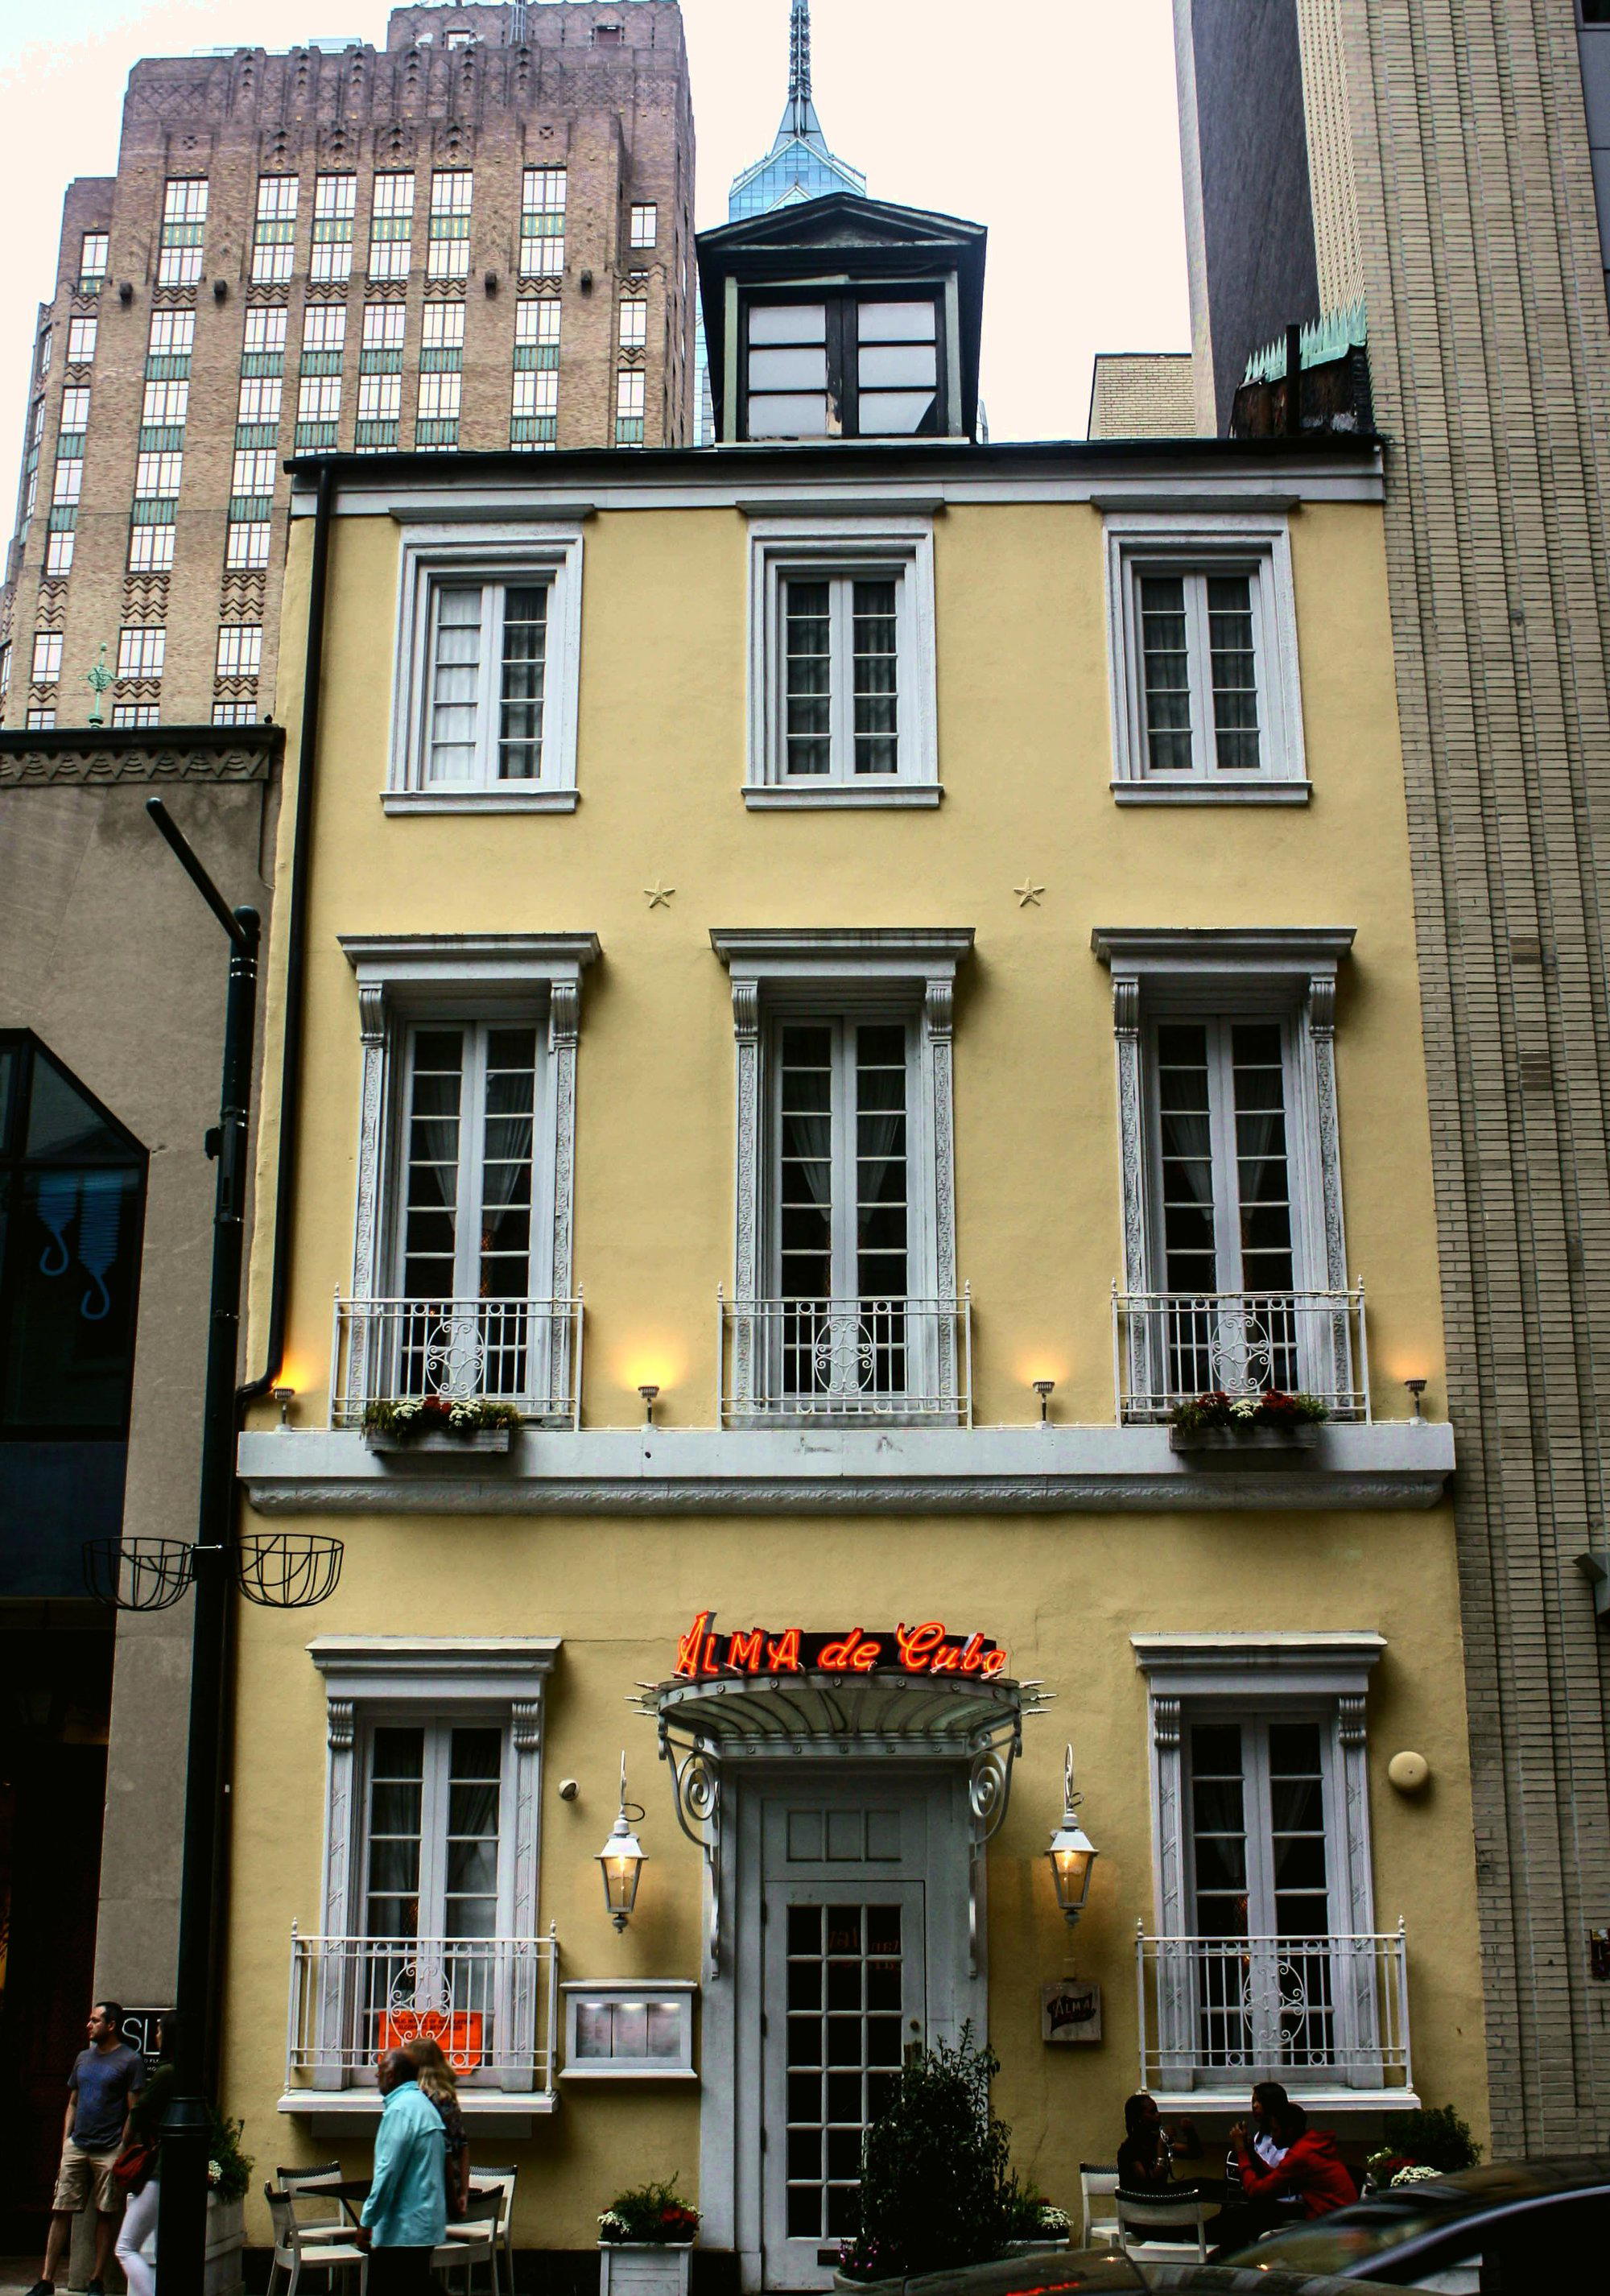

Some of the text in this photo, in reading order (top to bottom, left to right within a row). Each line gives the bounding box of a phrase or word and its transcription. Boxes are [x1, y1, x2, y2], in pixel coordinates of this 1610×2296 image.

[676, 1611, 1007, 1678] ALMA de Cuba
